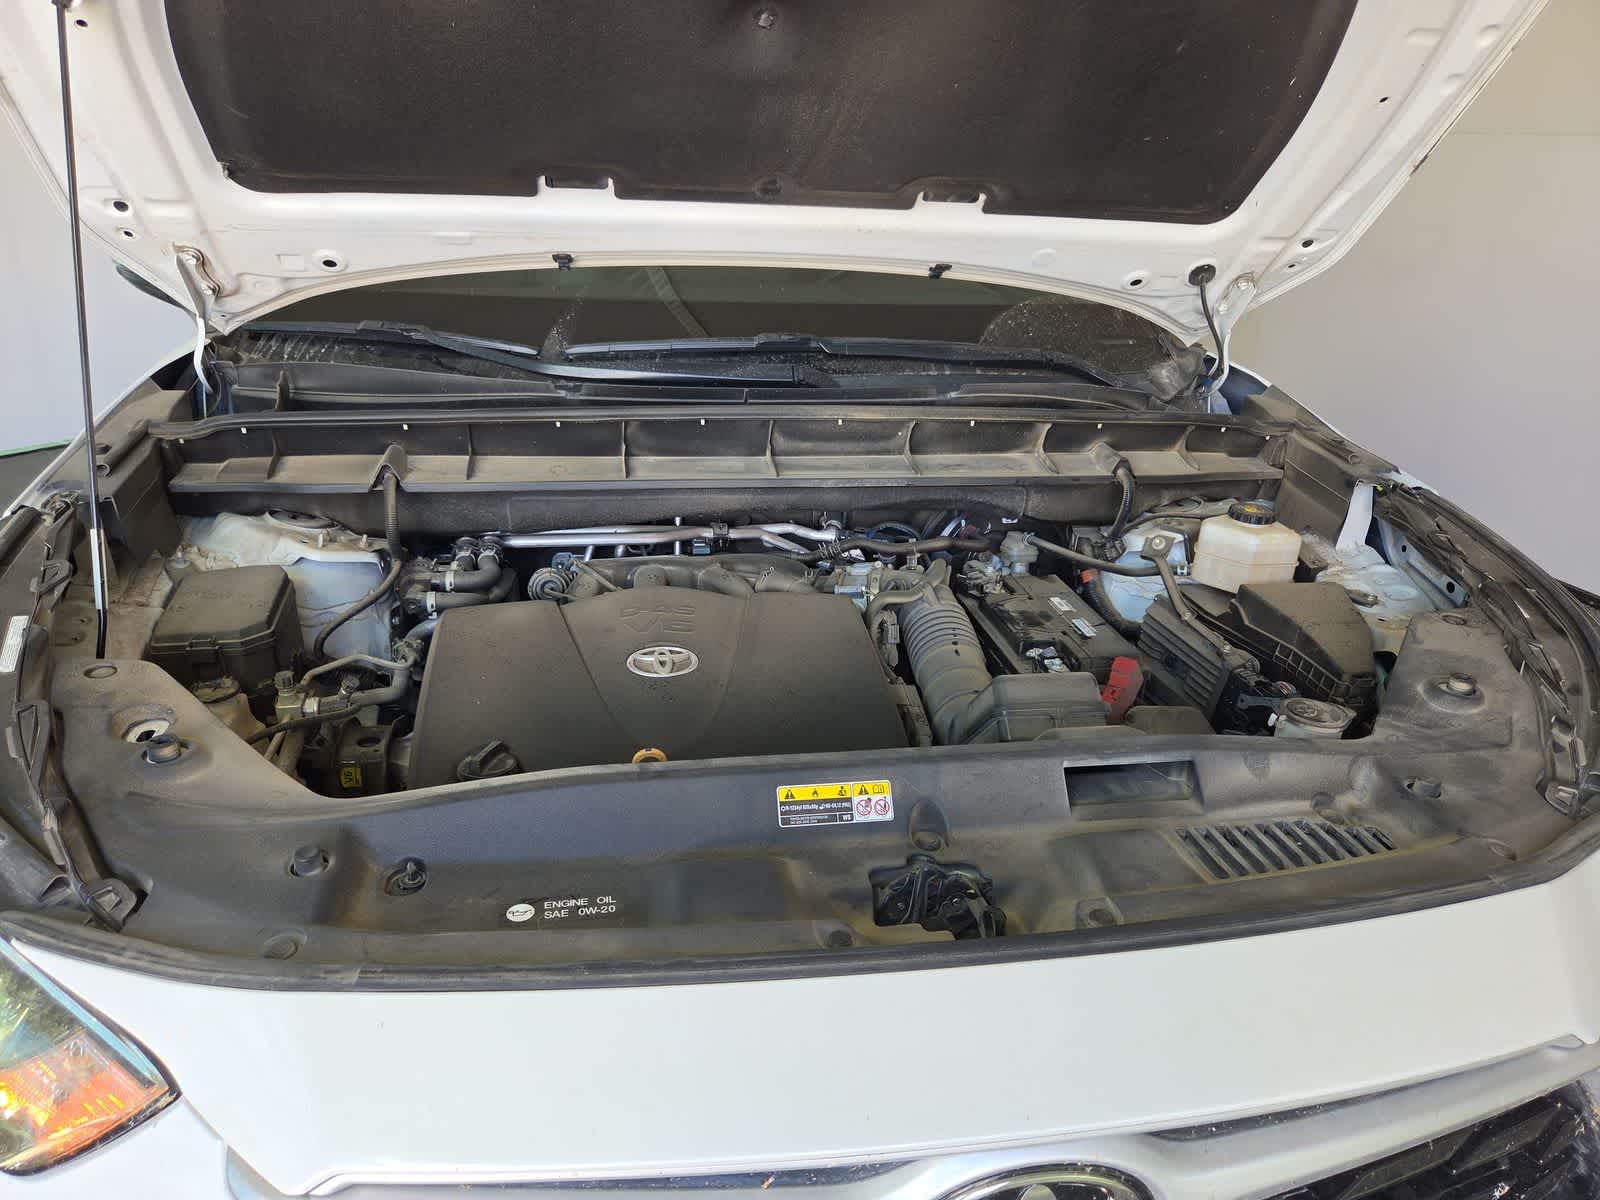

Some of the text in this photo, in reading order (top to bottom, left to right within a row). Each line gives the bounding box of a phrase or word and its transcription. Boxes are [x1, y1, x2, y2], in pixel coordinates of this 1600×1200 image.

[544, 895, 616, 909] ENGINE OIL
[544, 905, 616, 919] SAE 0W-20
